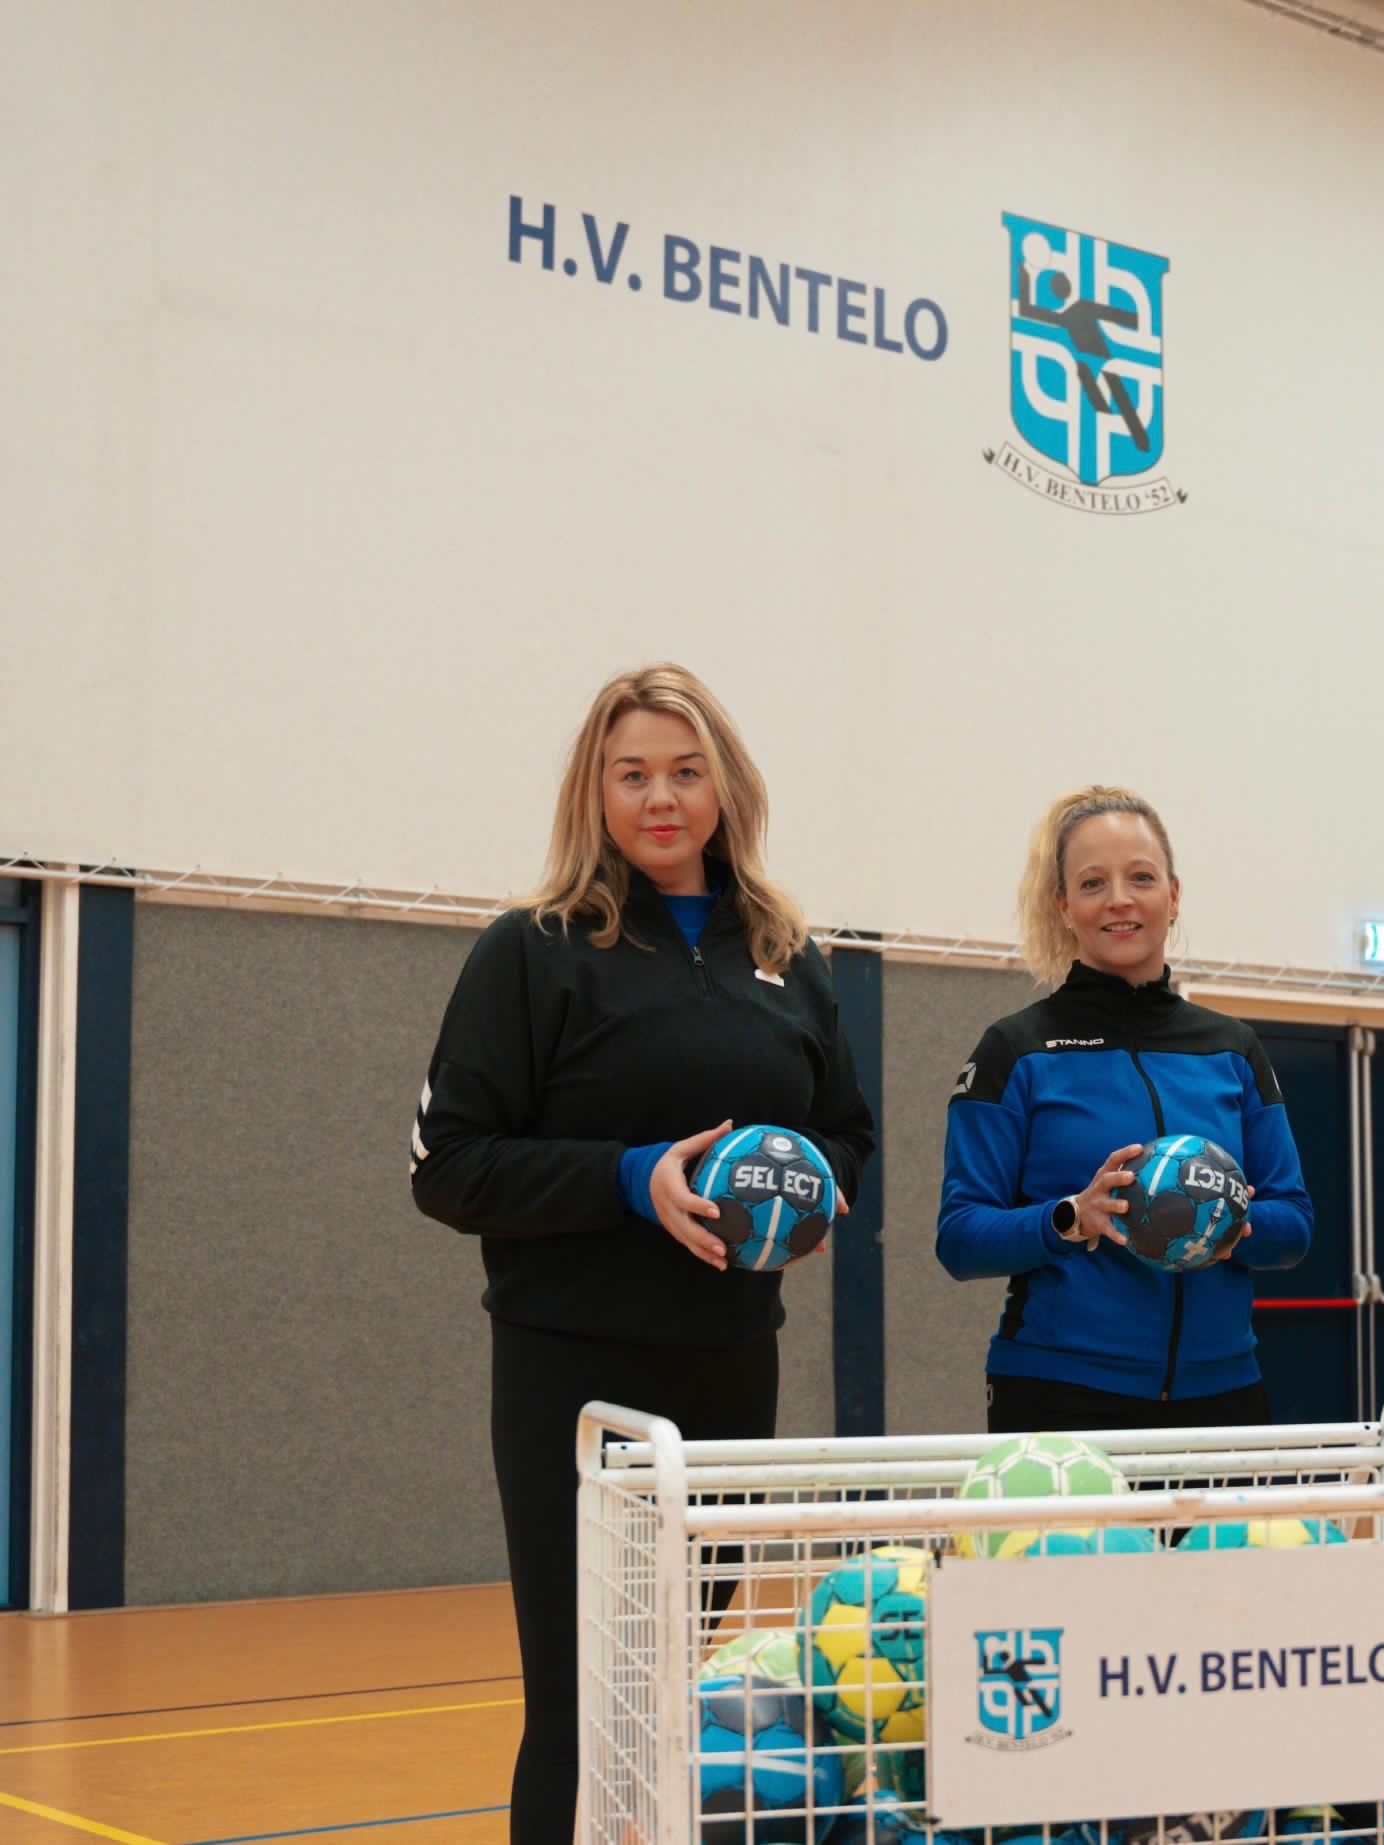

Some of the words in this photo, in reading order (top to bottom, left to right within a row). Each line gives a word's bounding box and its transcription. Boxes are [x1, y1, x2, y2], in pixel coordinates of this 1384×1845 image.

[508, 194, 642, 292] H.V.
[662, 234, 949, 361] BENTELO
[1003, 452, 1040, 489] H.V.
[1045, 478, 1141, 511] BENTELO
[1045, 1037, 1105, 1049] STANNO
[734, 1164, 822, 1202] SELECT
[1099, 1653, 1187, 1698] H.V.
